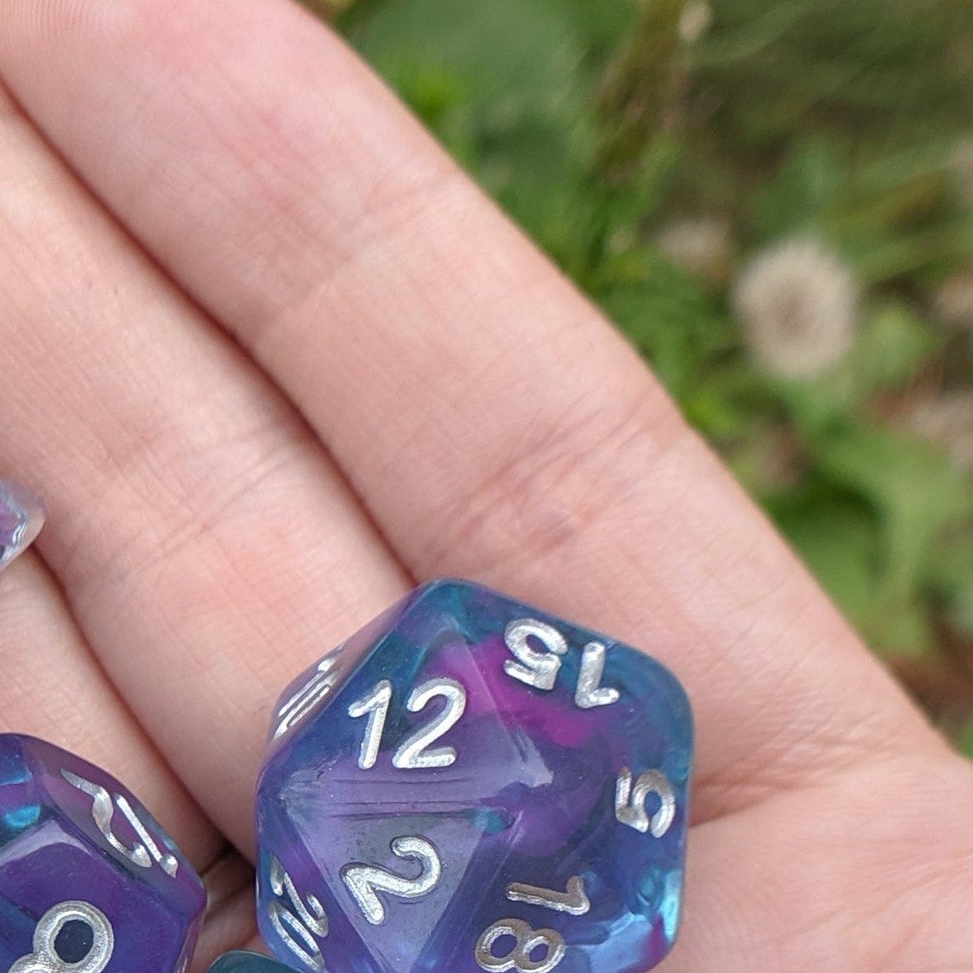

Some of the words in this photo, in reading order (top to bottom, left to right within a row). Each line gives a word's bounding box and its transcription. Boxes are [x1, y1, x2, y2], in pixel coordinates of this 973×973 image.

[503, 618, 621, 709] 15
[348, 678, 467, 770] 12
[615, 767, 676, 838] 5
[341, 834, 441, 925] 2
